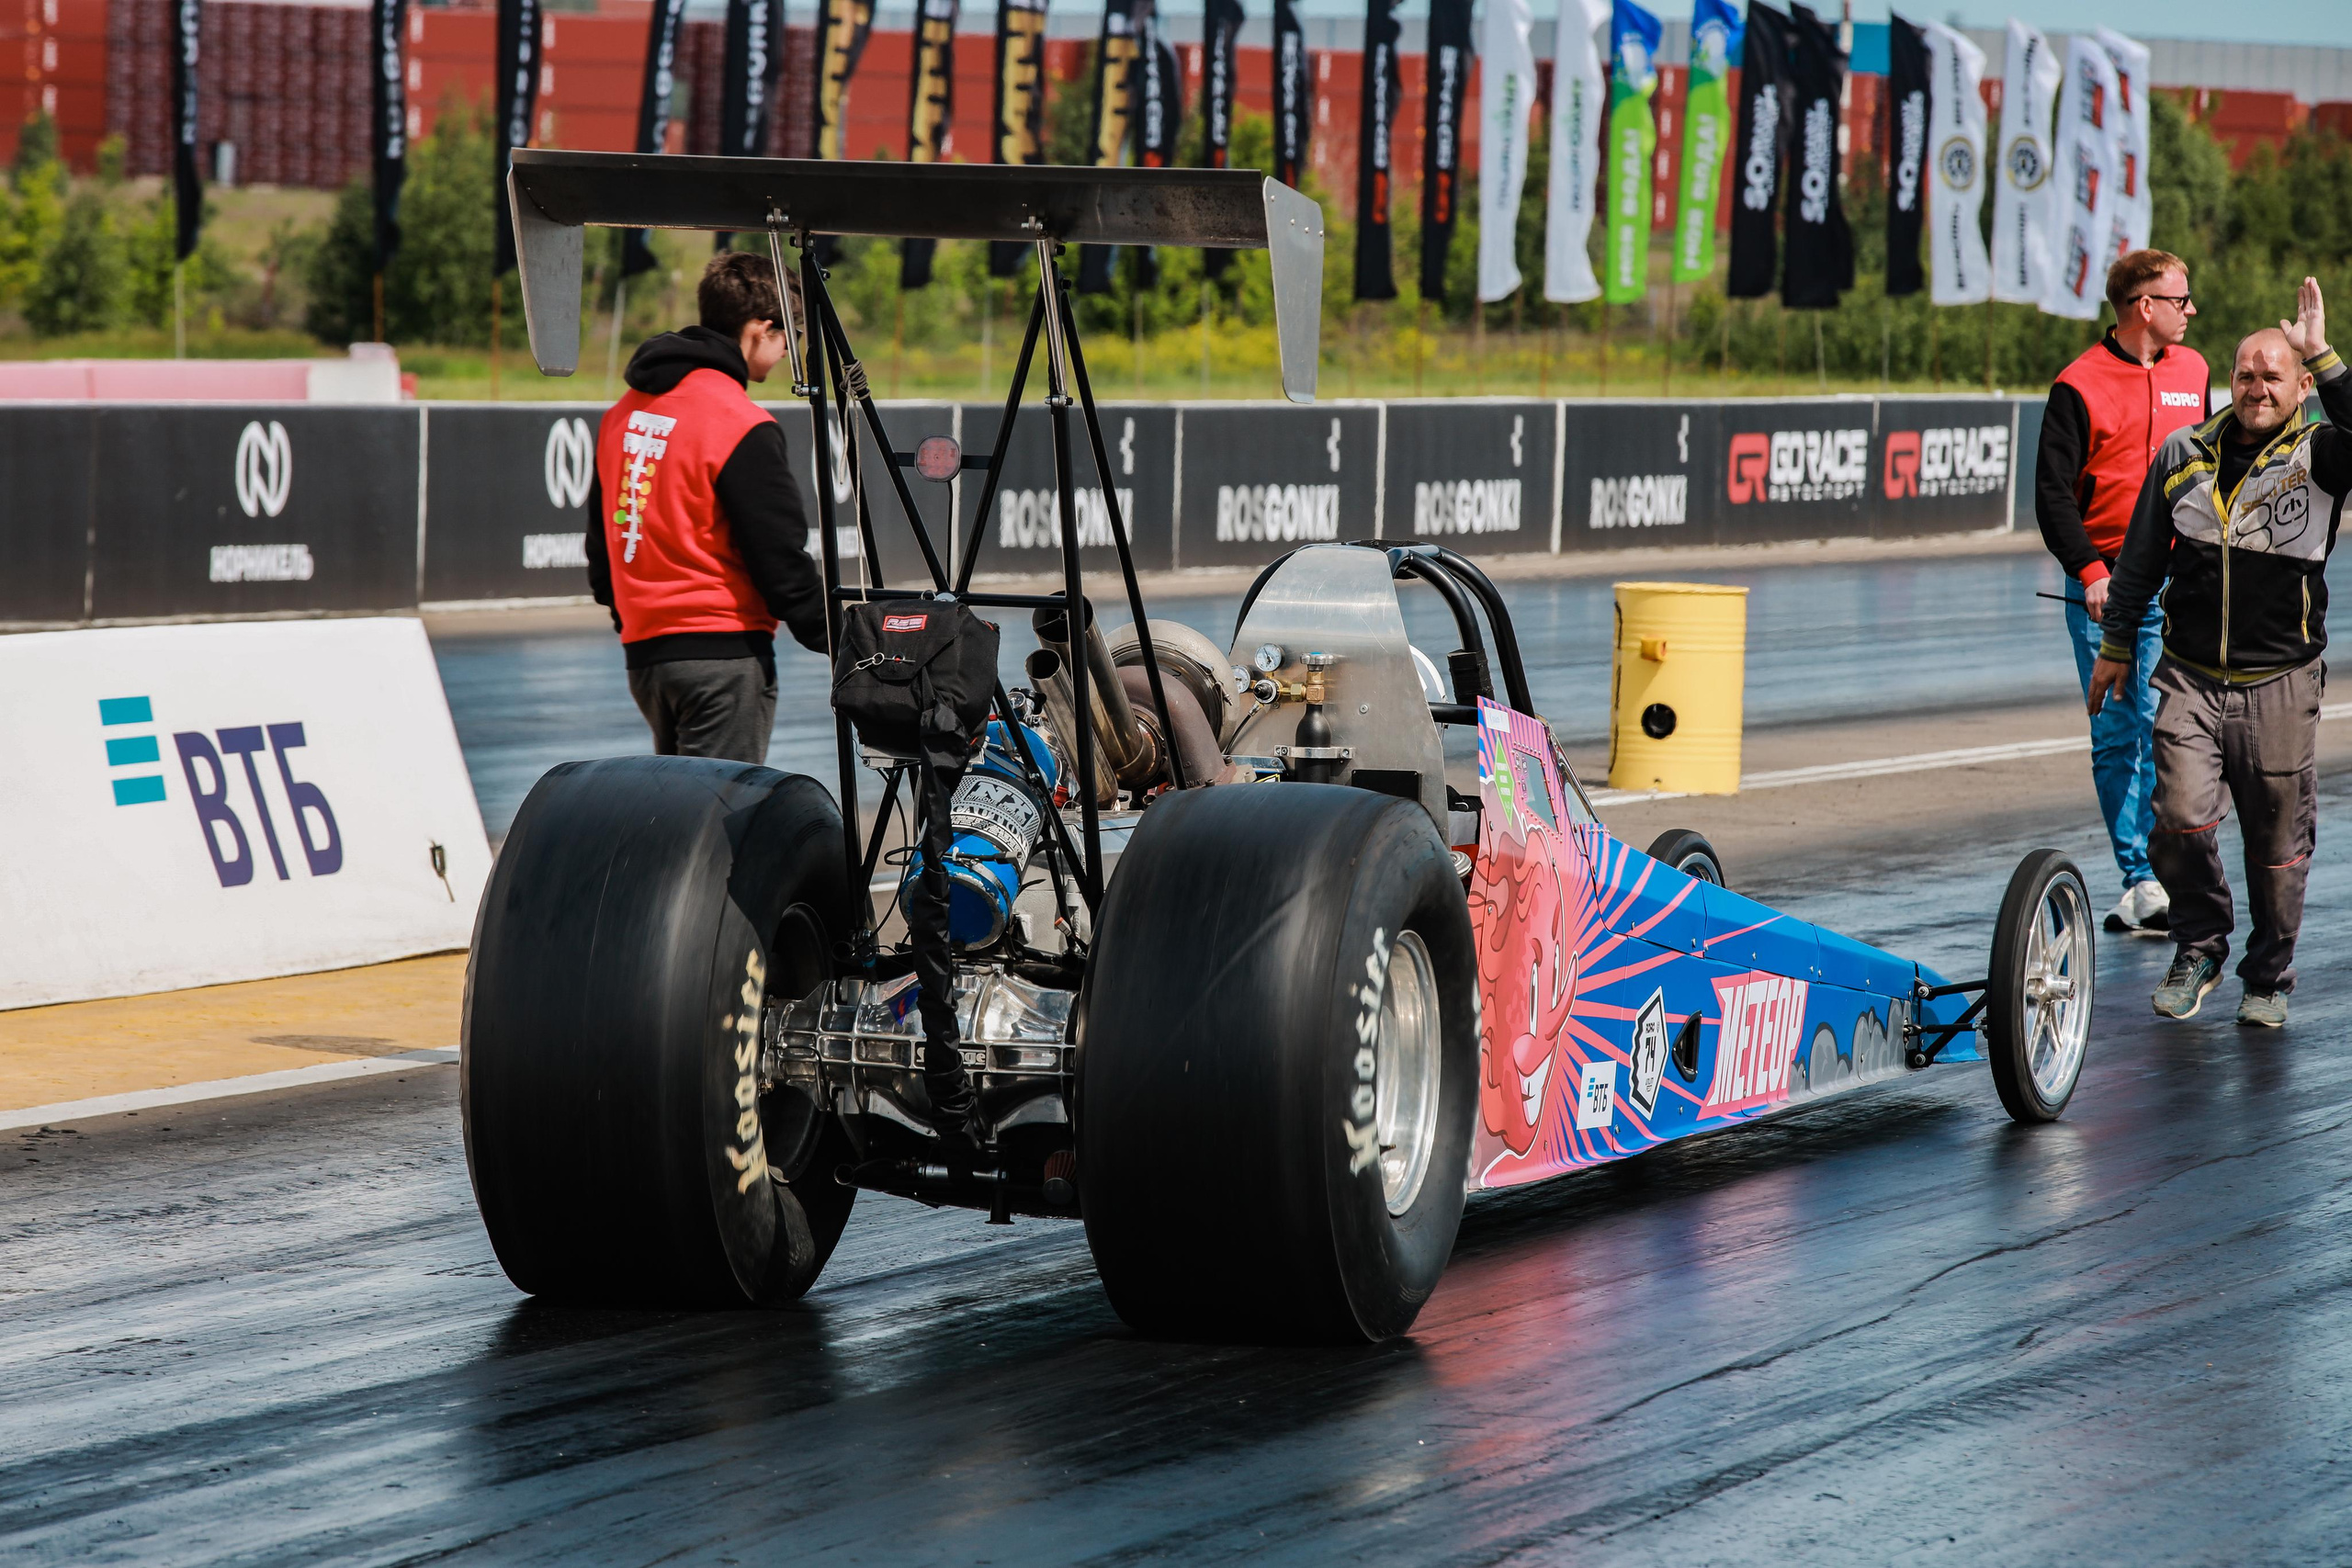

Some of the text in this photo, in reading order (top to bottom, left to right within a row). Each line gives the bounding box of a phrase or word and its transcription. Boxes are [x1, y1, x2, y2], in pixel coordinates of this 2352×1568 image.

[1216, 483, 1340, 542] ROSGONKI
[1414, 479, 1521, 535] ROSGONKI
[1589, 473, 1688, 528] ROSGONKI
[173, 721, 344, 888] ВТБ
[952, 805, 1028, 850] CAUTION
[965, 781, 1034, 827] NX
[722, 948, 769, 1194] Hoosier
[1342, 927, 1389, 1178] Hoosier
[1593, 1083, 1609, 1112] ВТБ
